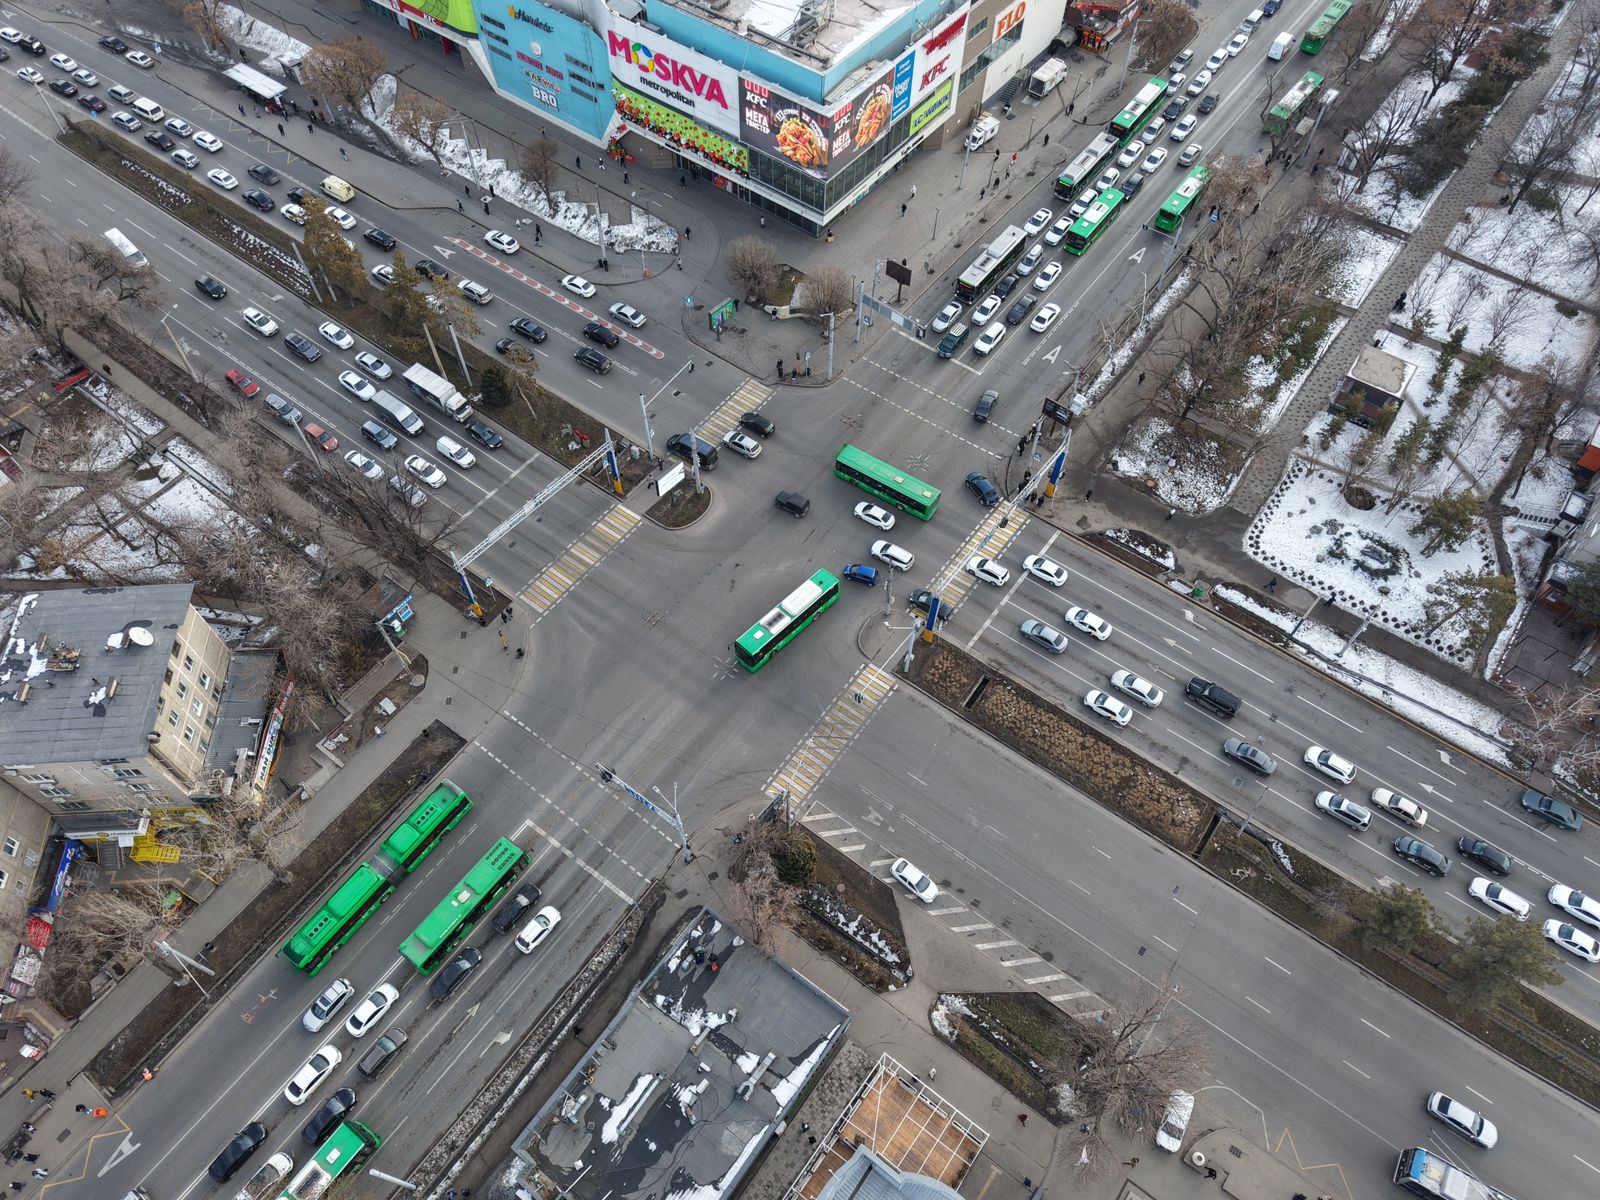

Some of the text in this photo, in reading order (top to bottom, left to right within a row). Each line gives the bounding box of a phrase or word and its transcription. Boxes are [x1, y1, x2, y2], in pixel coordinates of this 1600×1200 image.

[423, 13, 436, 25] KFC
[995, 1, 1026, 39] FLO
[608, 30, 728, 110] MOSKVA
[919, 53, 951, 92] KFC
[531, 85, 558, 108] BRO
[640, 76, 695, 108] metropolitan
[745, 91, 768, 108] KFC
[745, 107, 769, 128] МЕГА
[833, 112, 852, 133] KFC
[832, 130, 851, 151] МЕГА
